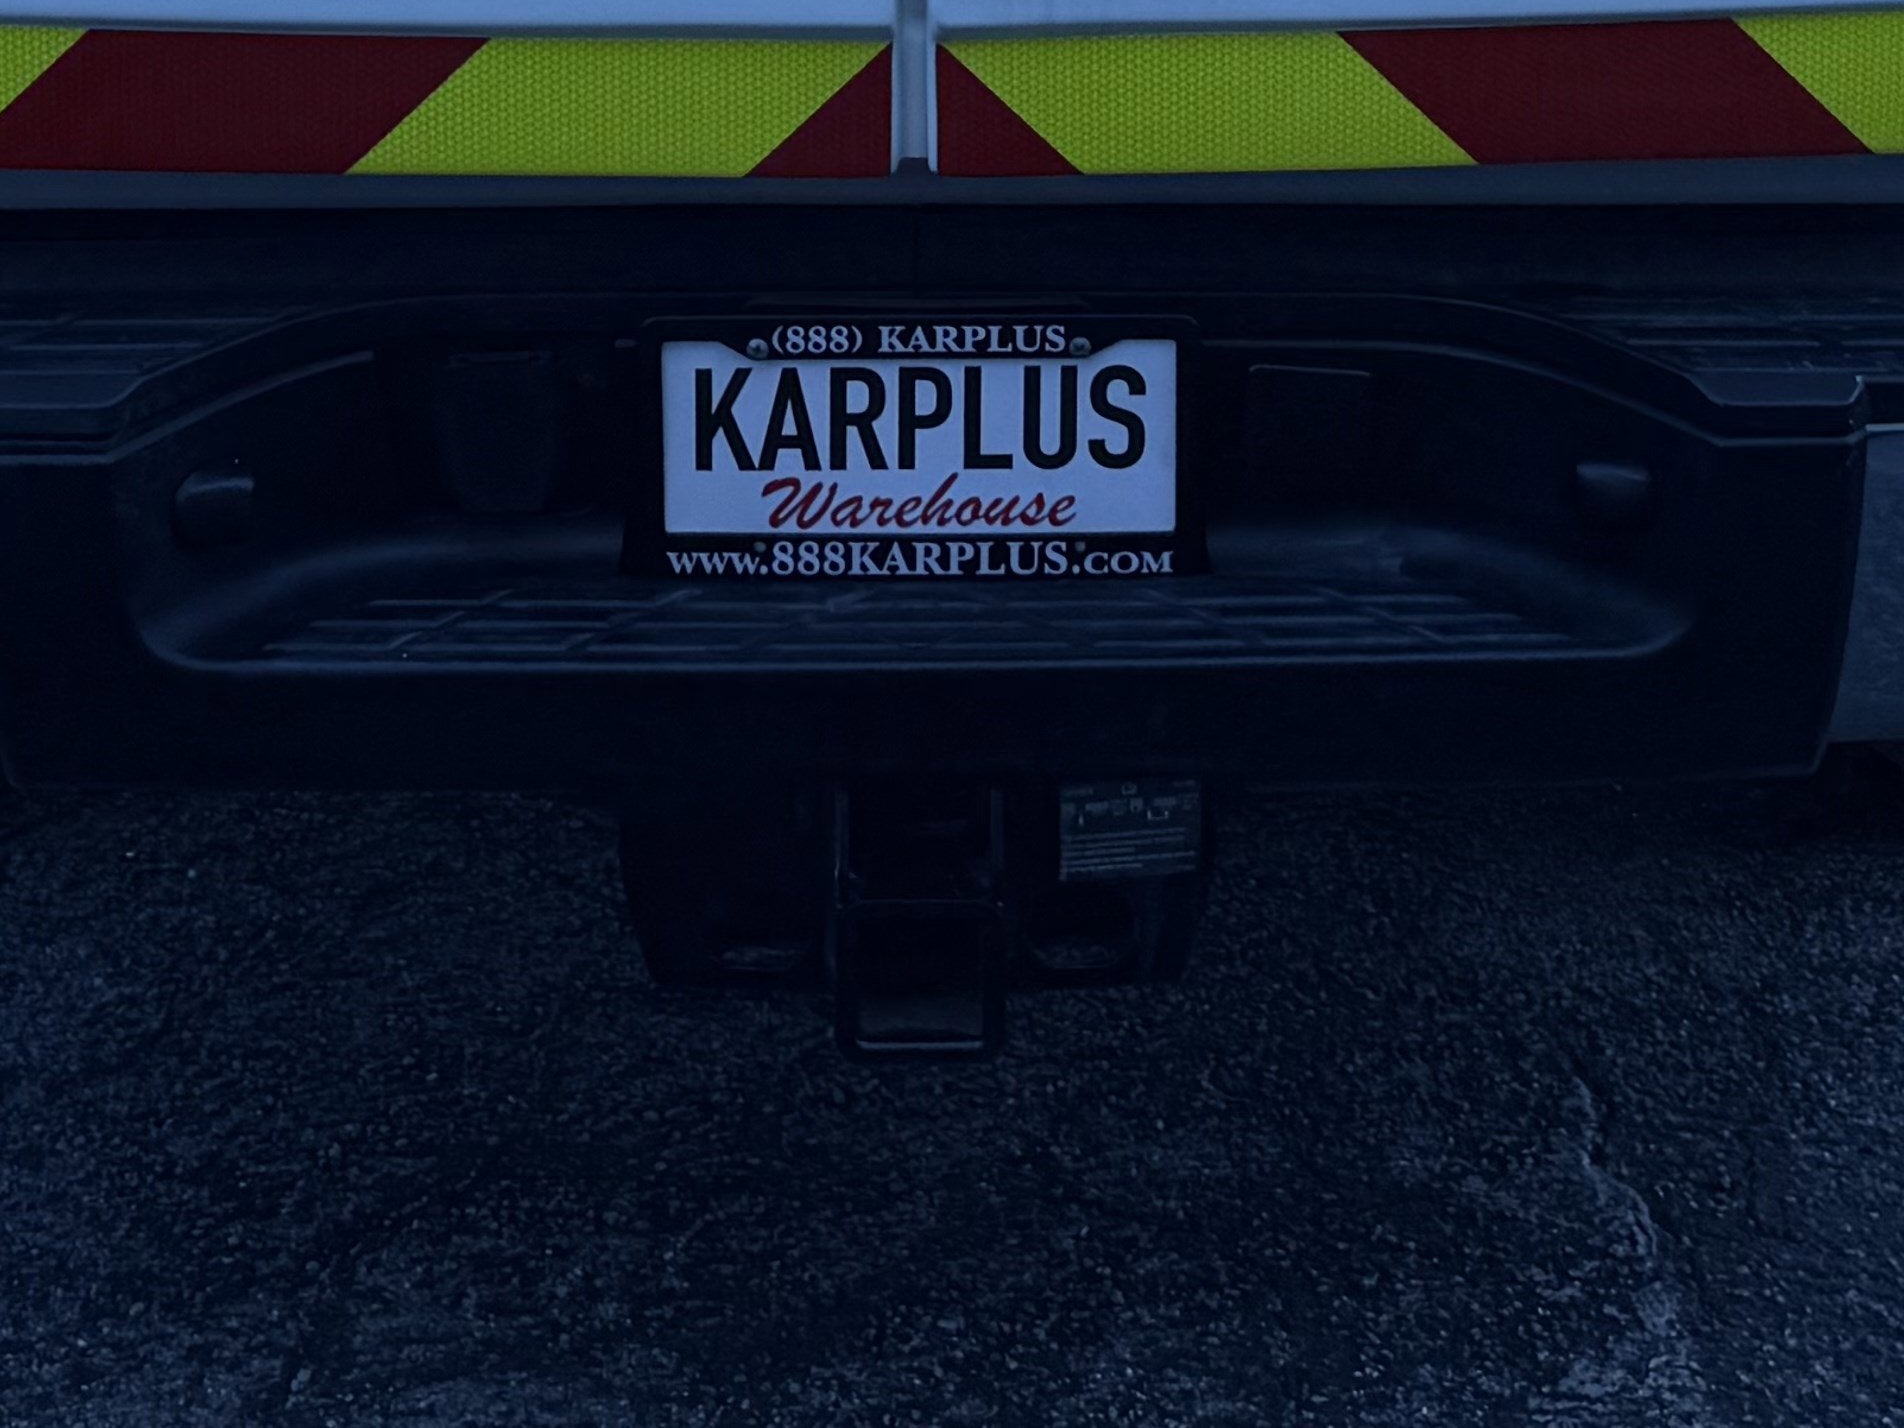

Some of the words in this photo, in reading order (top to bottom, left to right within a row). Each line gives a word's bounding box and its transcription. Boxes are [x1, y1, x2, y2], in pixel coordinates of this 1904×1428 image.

[771, 325, 863, 354] (888)
[878, 324, 1066, 353] KARPLUS
[695, 364, 1147, 472] KARPLUS
[761, 472, 1077, 530] Warehouse
